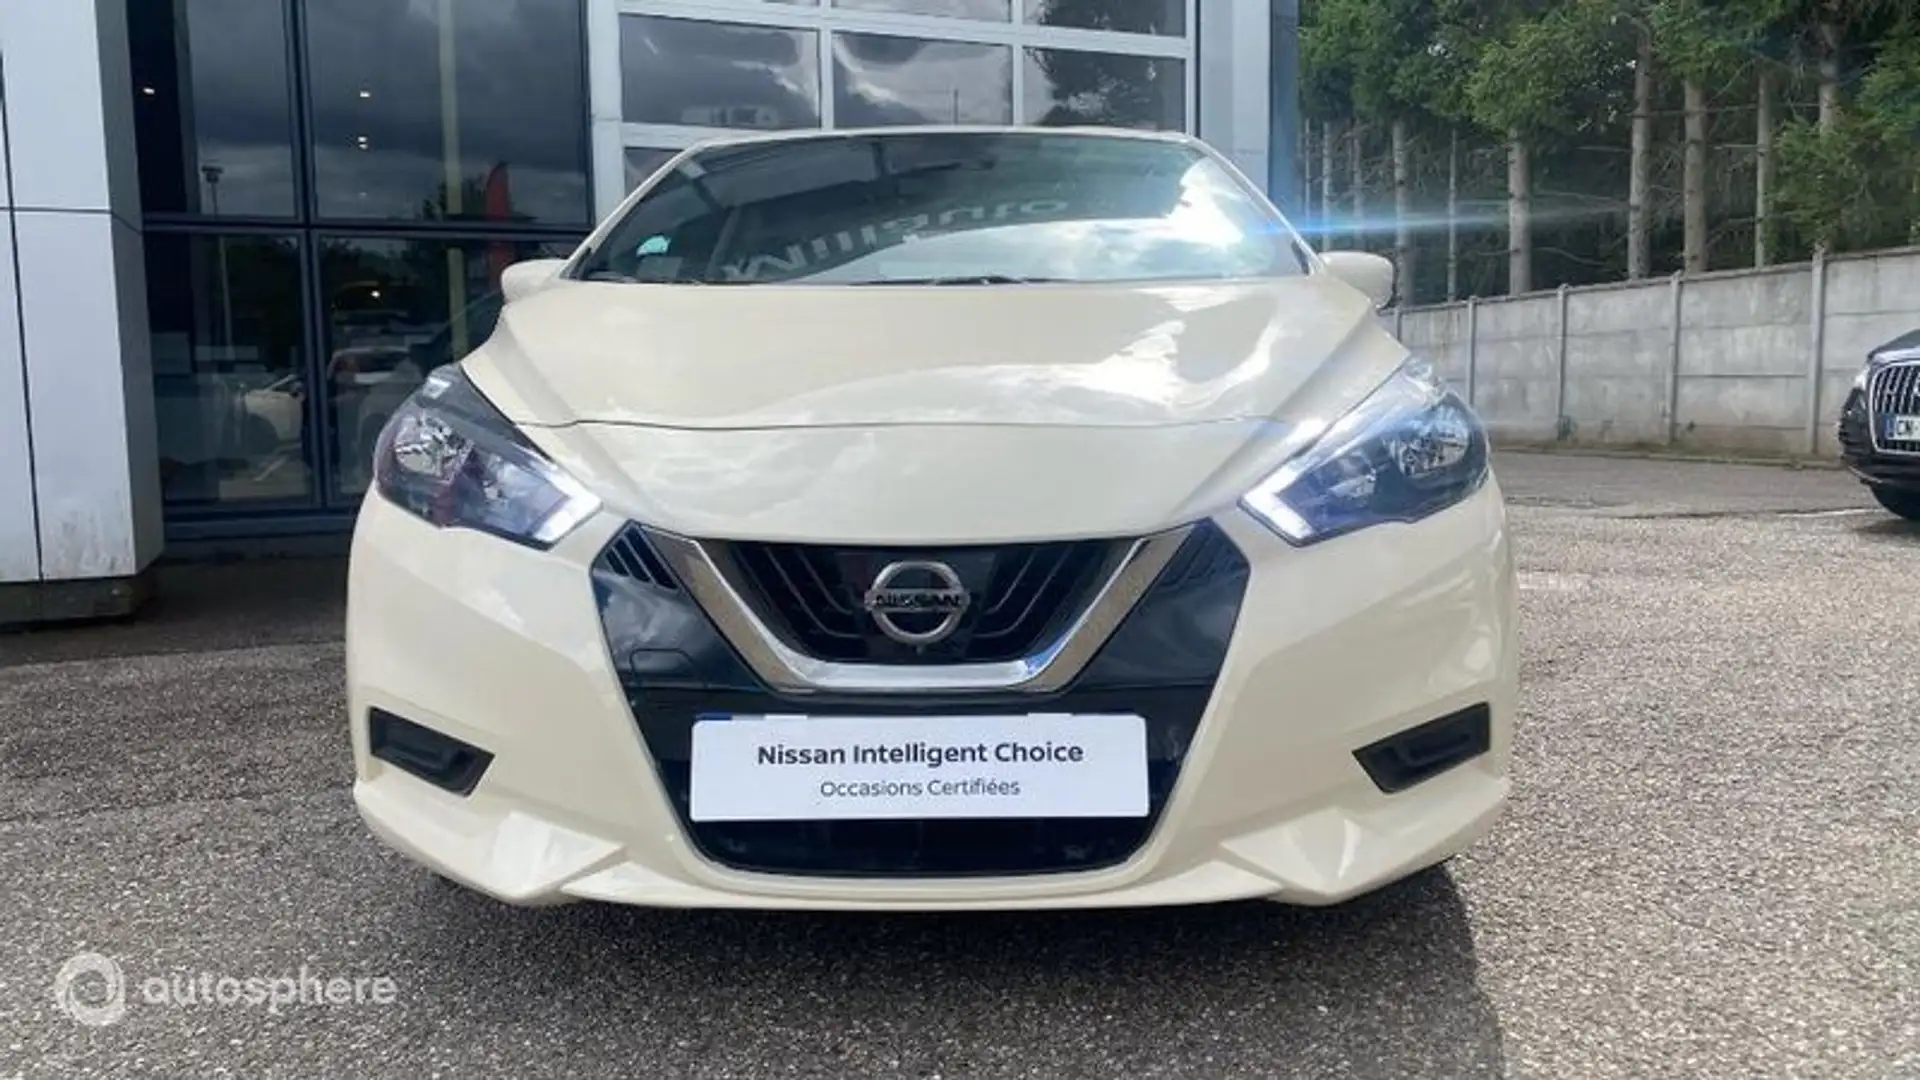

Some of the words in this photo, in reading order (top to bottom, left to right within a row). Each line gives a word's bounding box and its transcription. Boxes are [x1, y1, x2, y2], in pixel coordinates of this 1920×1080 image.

[864, 589, 970, 611] NISSAN
[757, 744, 846, 765] Nissan
[853, 742, 988, 768] Intelligent
[994, 741, 1085, 763] Choice
[820, 780, 923, 797] Occasions
[927, 777, 1021, 796] Certifiées
